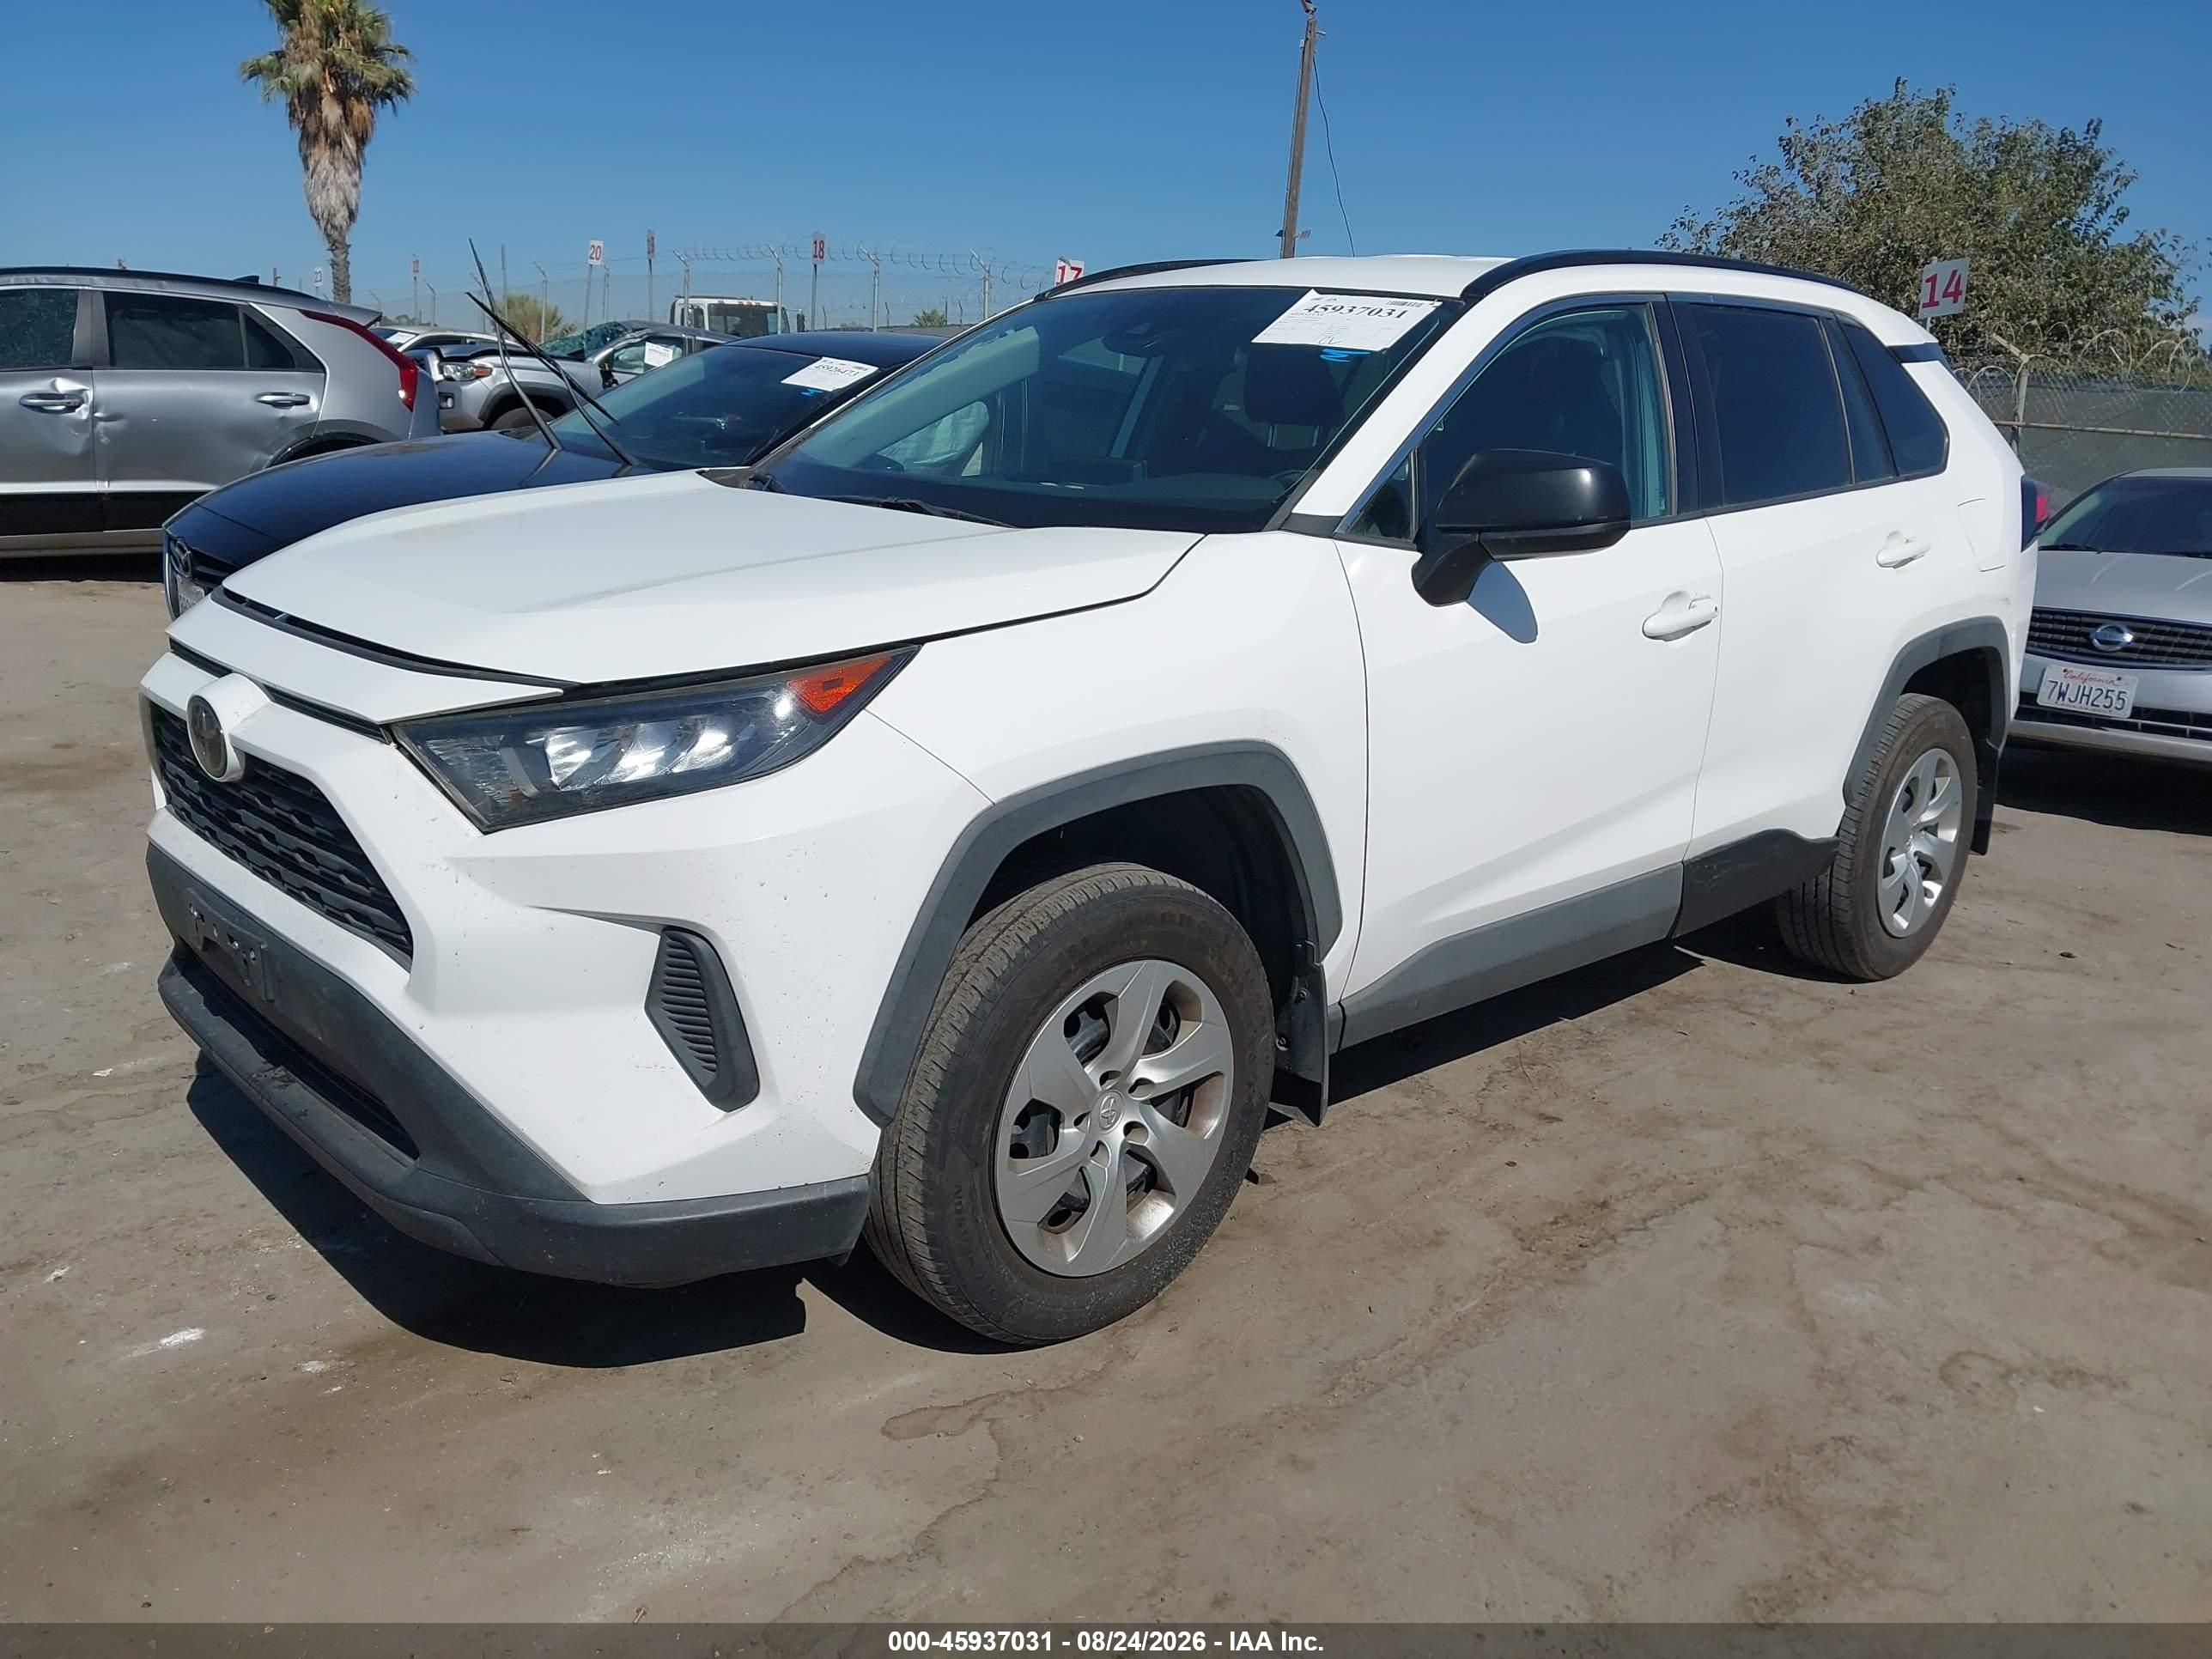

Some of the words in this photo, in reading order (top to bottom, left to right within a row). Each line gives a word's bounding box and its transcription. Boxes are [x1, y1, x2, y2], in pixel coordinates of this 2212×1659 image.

[589, 244, 602, 261] 20
[813, 240, 824, 259] 18
[313, 270, 323, 283] 23
[1056, 264, 1082, 286] 17
[1922, 268, 1963, 309] 14
[1304, 303, 1409, 319] 45937031
[2063, 669, 2120, 686] California
[2047, 679, 2128, 711] 7WJH255
